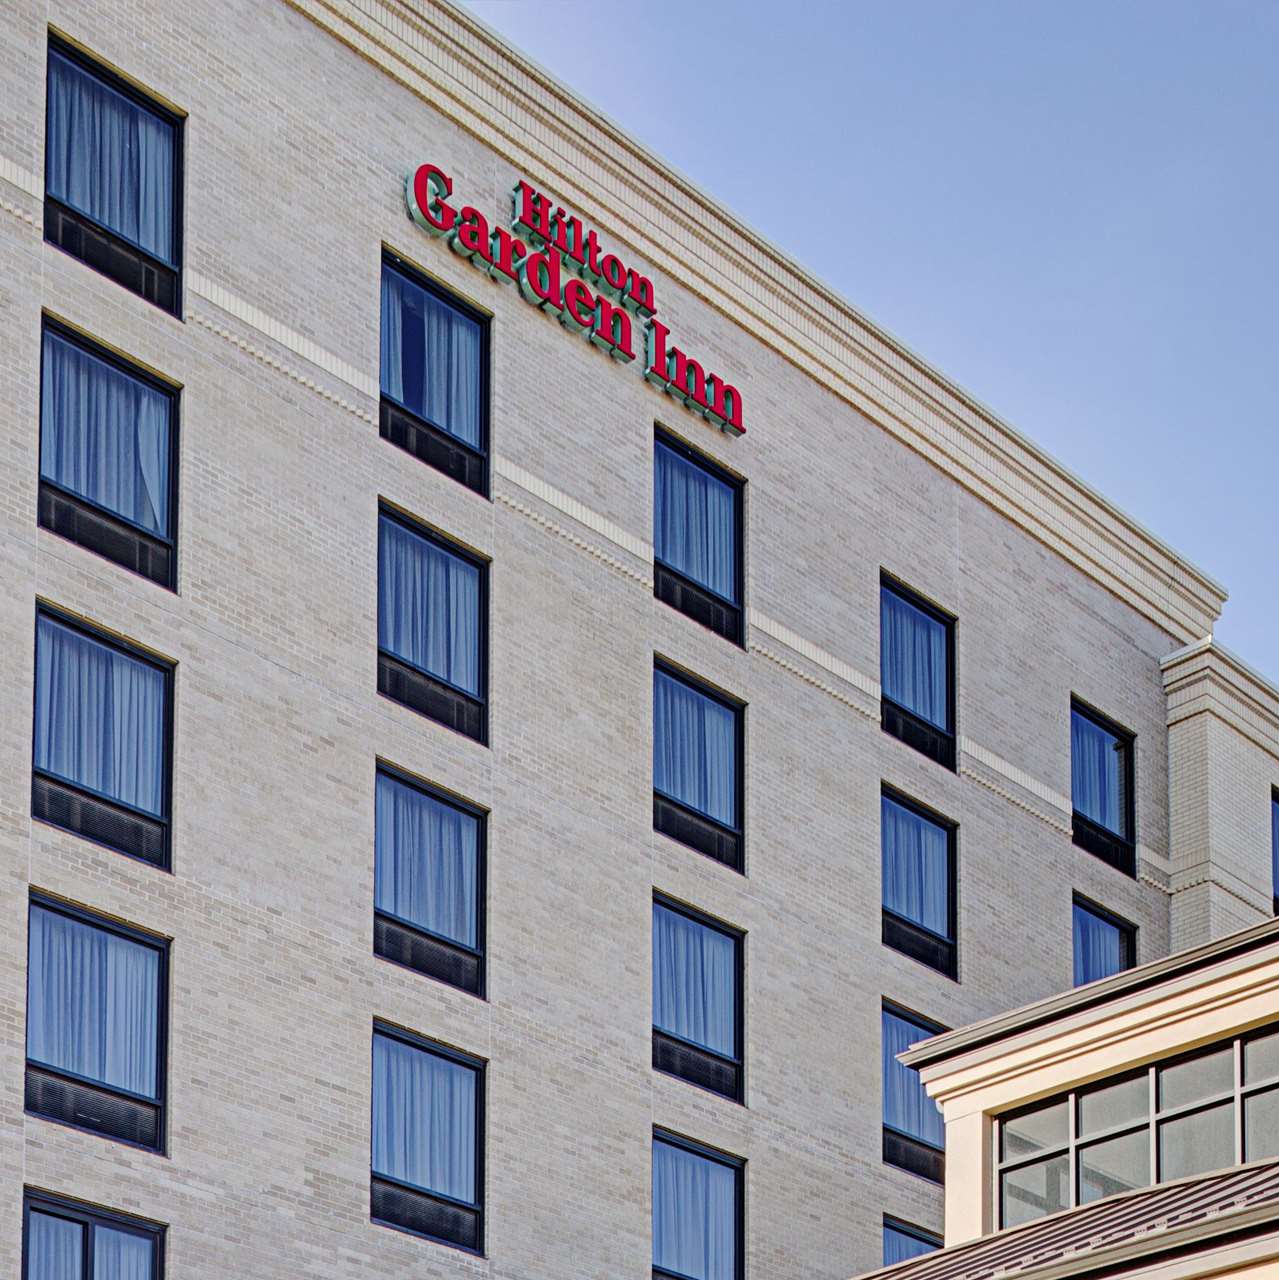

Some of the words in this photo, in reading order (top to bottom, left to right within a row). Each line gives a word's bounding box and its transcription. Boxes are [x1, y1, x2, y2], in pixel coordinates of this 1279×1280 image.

[406, 163, 636, 362] Garden
[645, 318, 746, 436] Inn
[514, 179, 657, 317] Hilton
